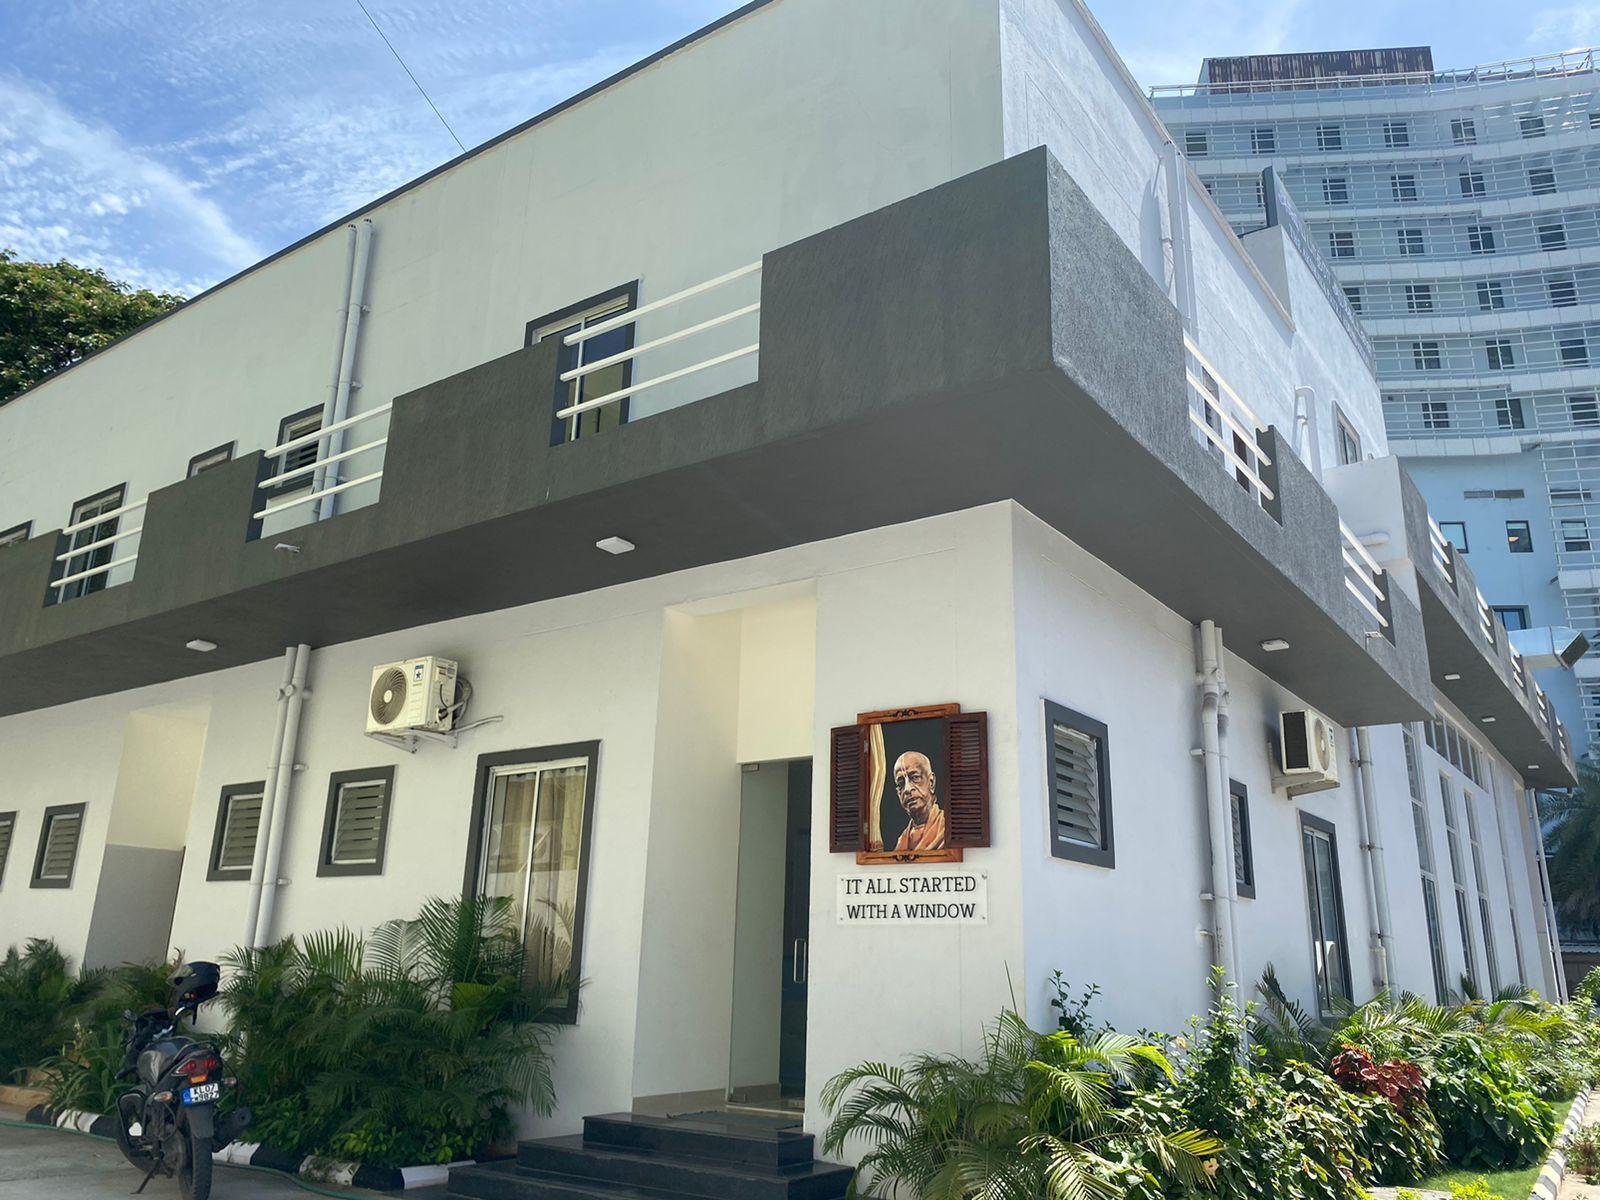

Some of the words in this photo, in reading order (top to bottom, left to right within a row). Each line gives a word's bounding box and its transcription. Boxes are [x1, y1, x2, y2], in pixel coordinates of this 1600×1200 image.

[846, 879, 862, 894] IT
[865, 878, 896, 894] ALL
[899, 876, 976, 893] STARTED
[846, 904, 887, 919] WITH
[890, 904, 901, 919] A
[904, 903, 976, 918] WINDOW
